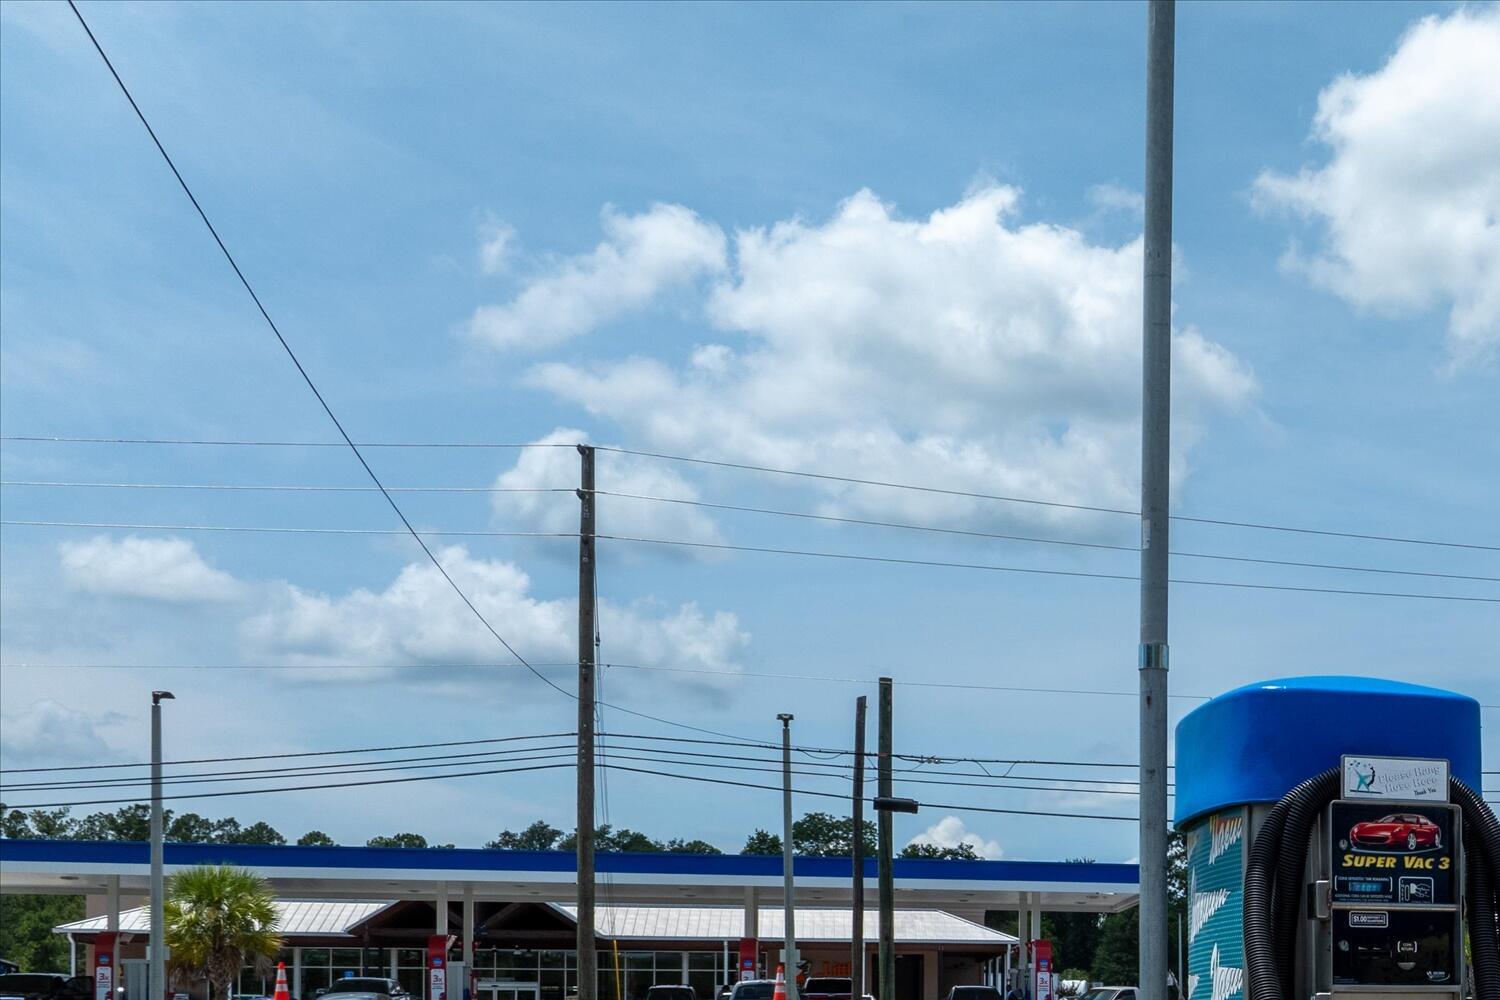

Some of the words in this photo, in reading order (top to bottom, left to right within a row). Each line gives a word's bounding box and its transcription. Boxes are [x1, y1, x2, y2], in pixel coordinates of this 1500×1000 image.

[1342, 854, 1397, 868] SUPER
[1403, 856, 1435, 869] VAC
[1438, 857, 1450, 870] 3
